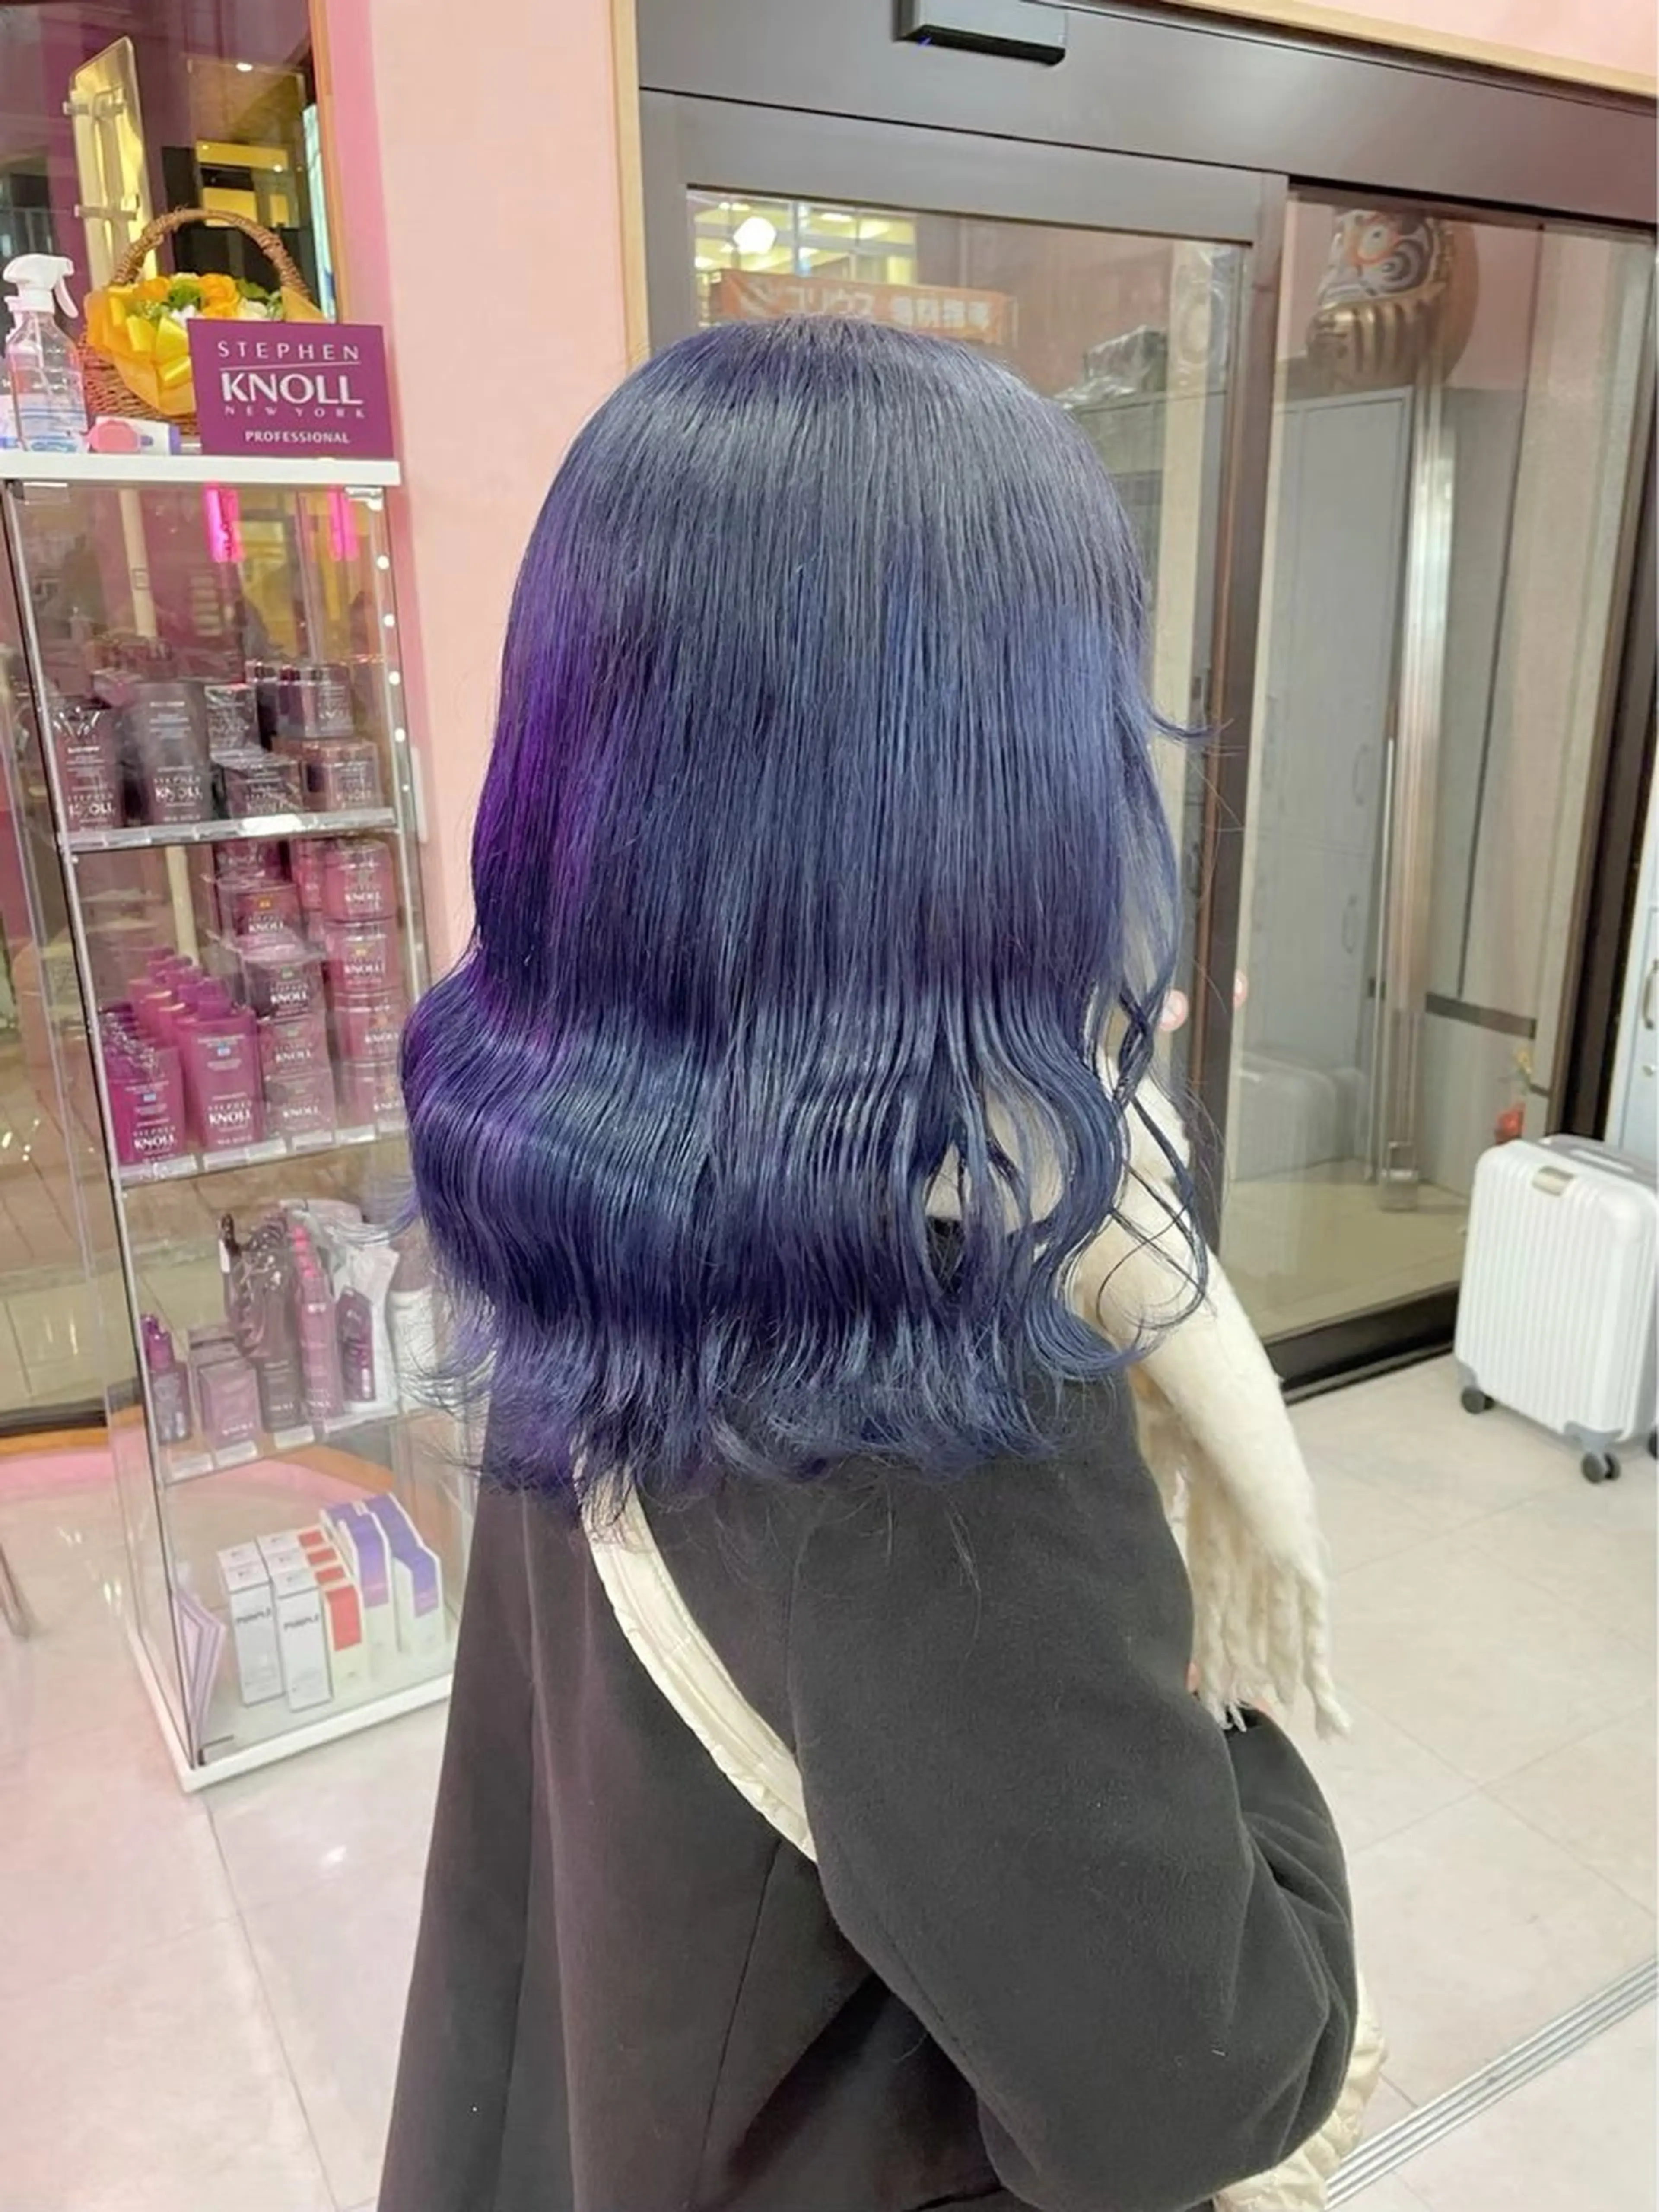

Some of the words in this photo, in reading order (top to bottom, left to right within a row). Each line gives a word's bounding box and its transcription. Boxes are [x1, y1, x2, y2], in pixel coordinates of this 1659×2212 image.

[217, 340, 359, 360] STEPHEN
[221, 372, 364, 405] KNOLL
[225, 405, 277, 416] NEW
[295, 407, 365, 418] YORK
[245, 430, 350, 443] PROFESSIONAL
[208, 1109, 251, 1125] KNOLL
[133, 1134, 175, 1151] KNOLL
